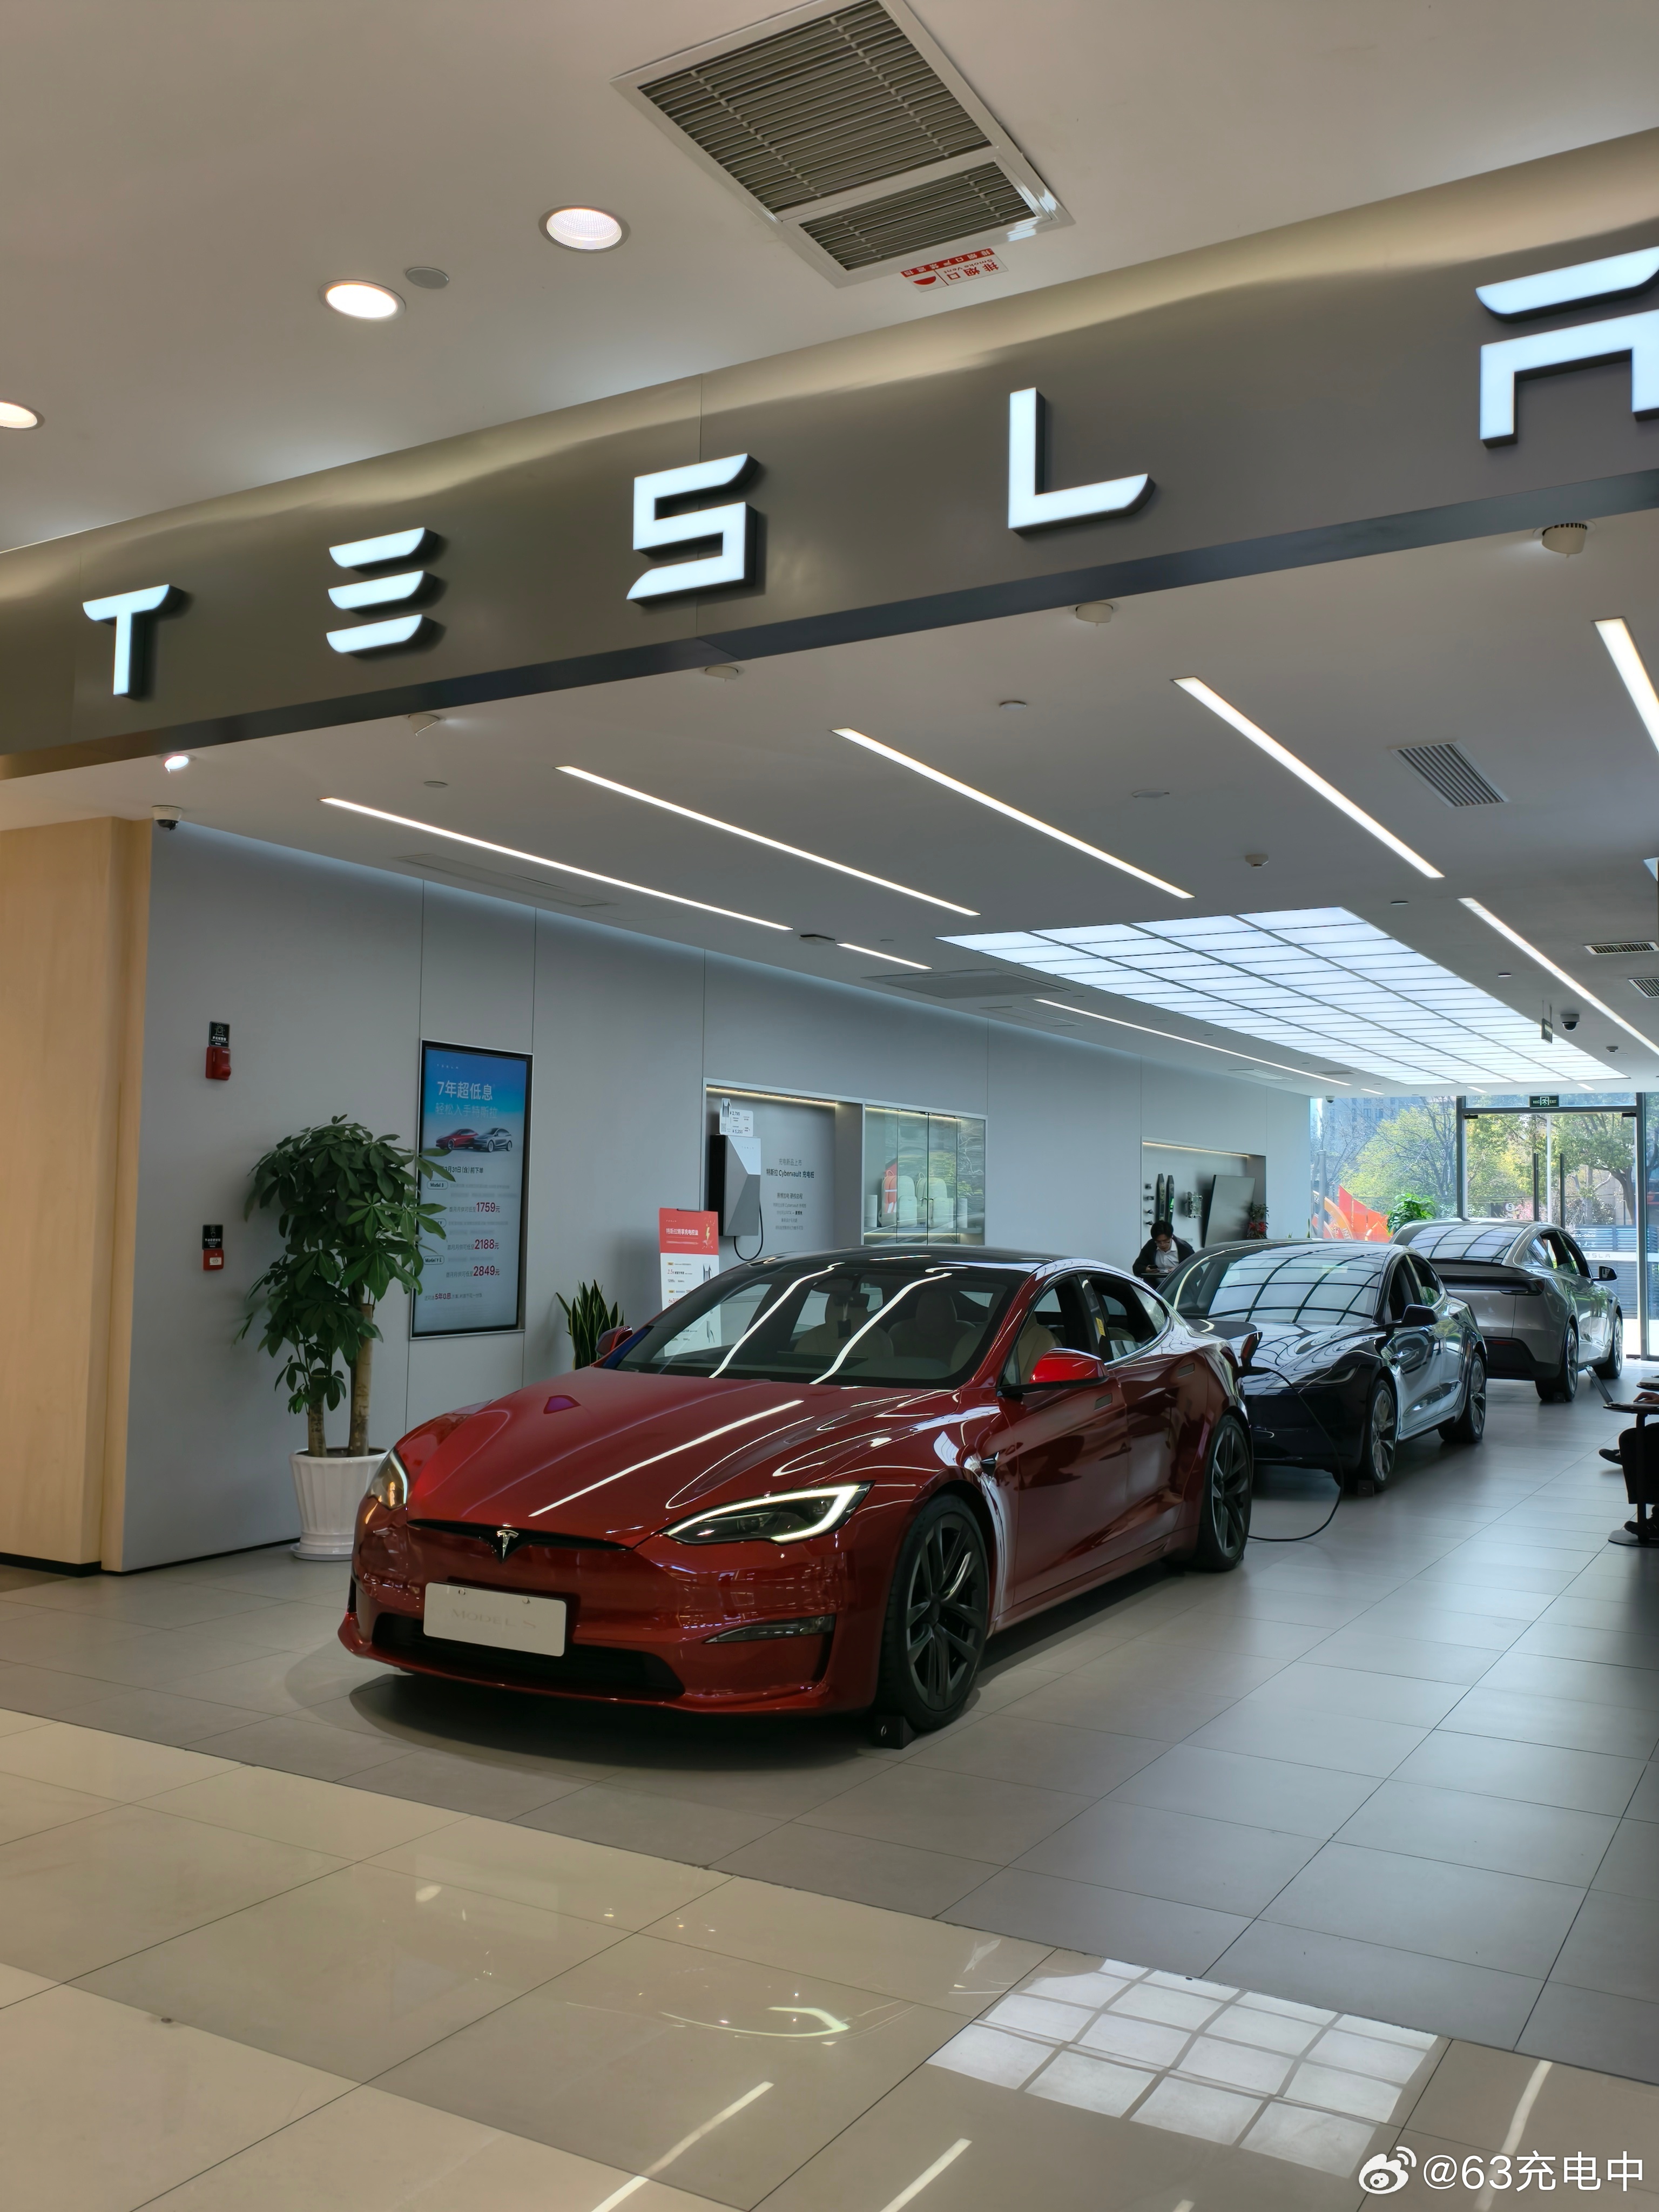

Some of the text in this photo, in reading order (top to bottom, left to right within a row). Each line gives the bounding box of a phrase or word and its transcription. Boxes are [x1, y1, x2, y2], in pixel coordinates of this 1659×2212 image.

[946, 262, 999, 281] 排烟口
[964, 259, 993, 268] Smoke
[82, 246, 1659, 696] TESLA
[437, 1080, 493, 1101] 7年超低息
[451, 1608, 516, 1627] MODEL
